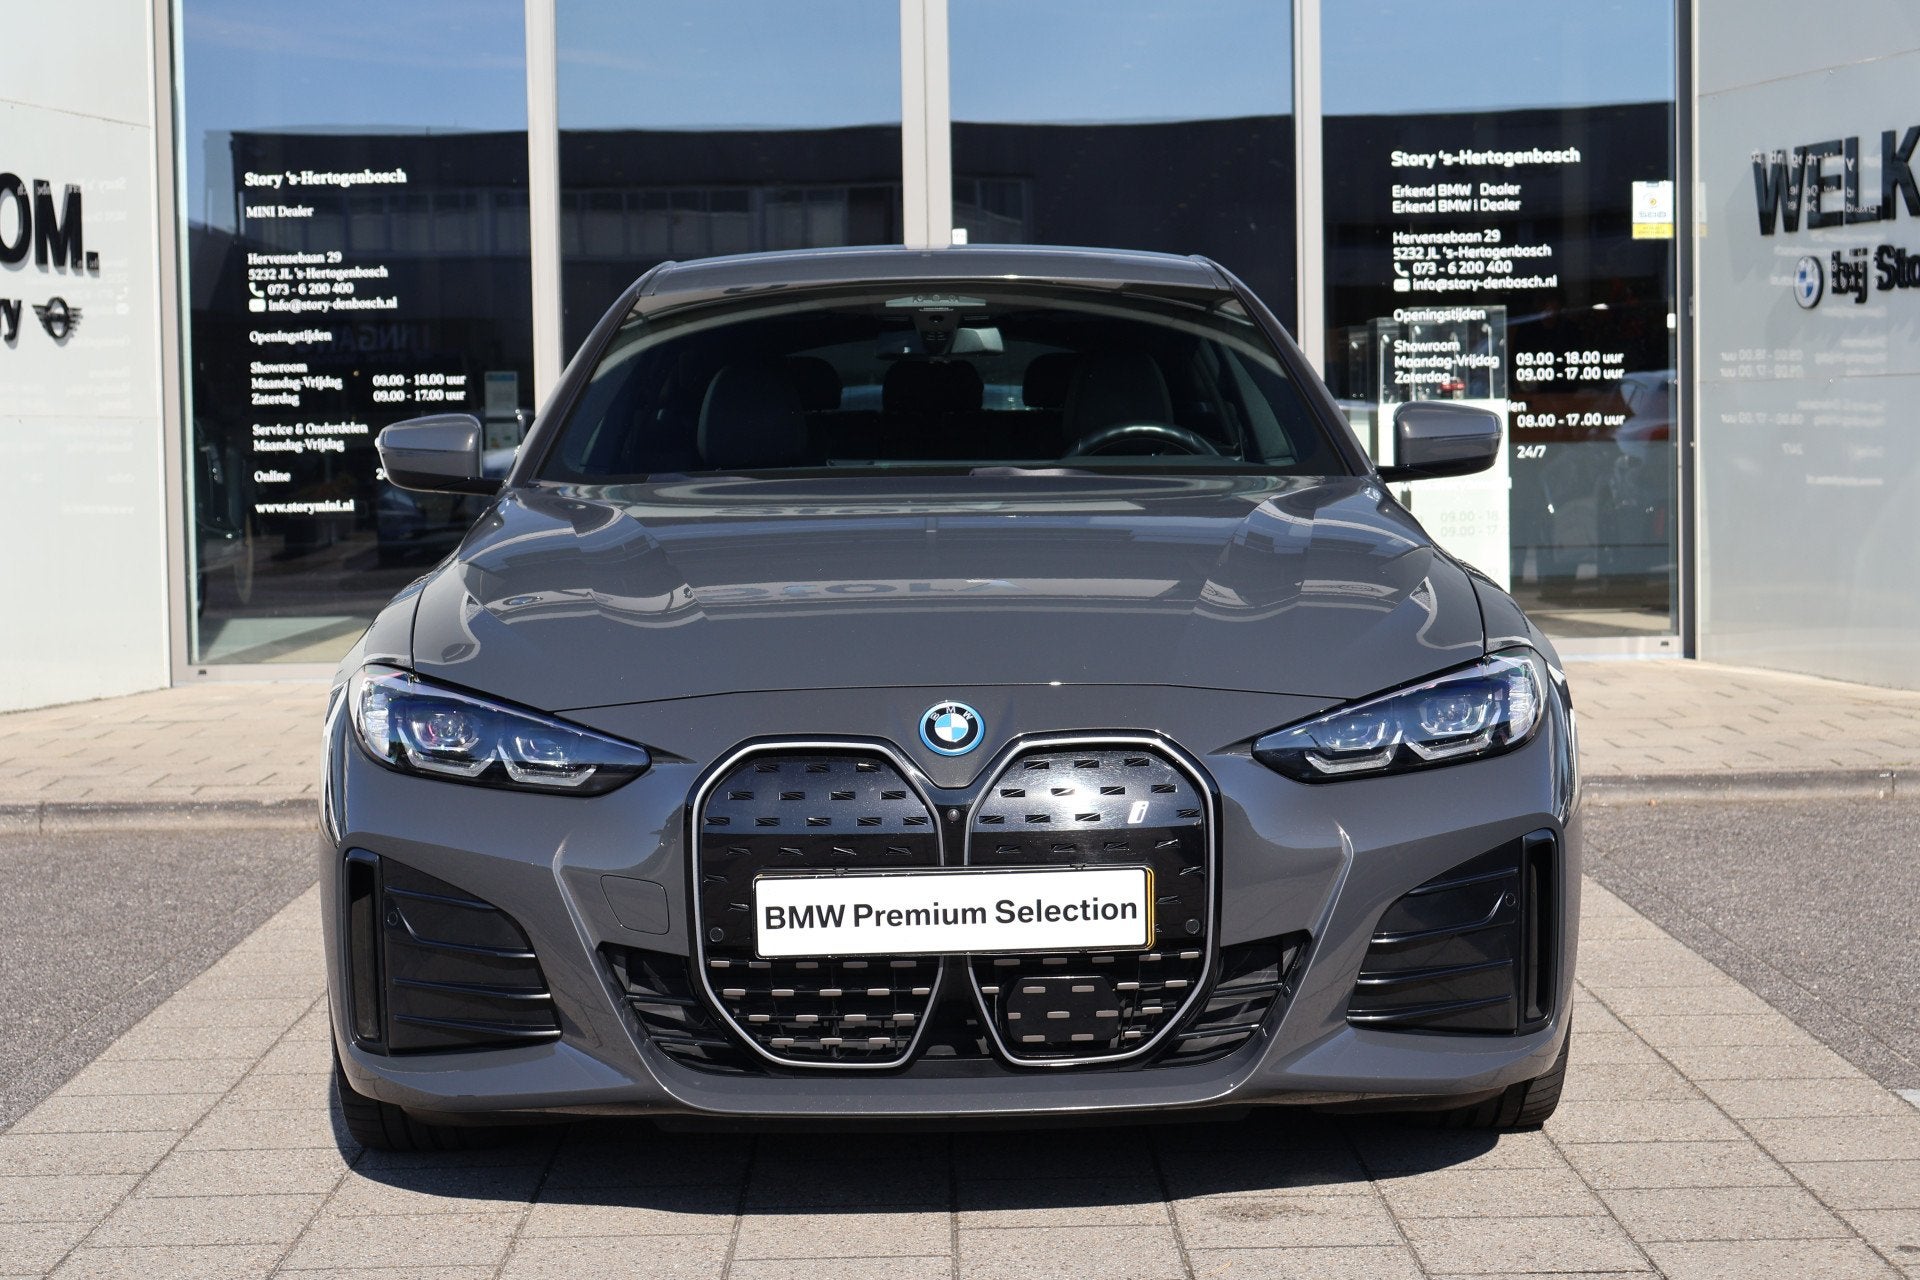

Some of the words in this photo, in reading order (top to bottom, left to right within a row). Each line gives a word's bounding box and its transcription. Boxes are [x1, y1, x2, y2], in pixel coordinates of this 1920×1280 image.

[1391, 150, 1436, 169] Story
[1438, 147, 1581, 167] 's-Hertogenbosch
[244, 171, 283, 189] Story
[286, 169, 407, 187] 's-Hertogenbosch
[1392, 185, 1435, 198] Erkend
[1437, 184, 1472, 196] BMW
[1479, 182, 1521, 196] Dealer
[246, 205, 276, 218] MINI
[278, 205, 314, 218] Dealer
[1392, 200, 1436, 214] Erkend
[1438, 199, 1472, 212] BMW
[1473, 199, 1479, 211] i
[1480, 198, 1521, 211] Dealer
[1393, 231, 1481, 245] Hervensebaan
[1483, 230, 1501, 242] 29
[247, 252, 325, 265] Hervensebaan
[327, 251, 342, 263] 29
[1393, 247, 1424, 260] 5232
[1443, 244, 1552, 259] 's-Hertogenbosch
[248, 268, 276, 280] 5232
[294, 266, 388, 280] 's-Hertogenbosch
[1412, 262, 1436, 276] 073
[1447, 262, 1457, 274] 6
[1458, 261, 1485, 274] 200
[1486, 261, 1513, 273] 400
[298, 283, 307, 295] 6
[308, 282, 330, 295] 200
[332, 282, 354, 294] 400
[1412, 275, 1558, 292] info@story-denbosch.nl
[268, 297, 398, 314] info@story-denbosch.nl
[1393, 308, 1486, 323] Openingstijden
[249, 329, 332, 345] Openingstijden
[1394, 340, 1460, 353] Showroom
[1394, 355, 1500, 368] Maandag-Vrijdag
[1515, 351, 1554, 366] 09.00
[1564, 351, 1601, 366] 18.00
[1603, 353, 1625, 364] uur
[250, 362, 308, 374] Showroom
[1516, 367, 1554, 382] 09.00
[1603, 369, 1625, 380] uur
[251, 376, 343, 390] Maandag-Vrijdag
[372, 374, 404, 386] 09.00
[414, 374, 444, 386] 18.00
[446, 376, 466, 386] uur
[1394, 371, 1451, 384] Zaterdag
[252, 393, 300, 406] Zaterdag
[373, 390, 404, 402] 09.00
[446, 391, 466, 401] uur
[1517, 413, 1556, 428] 08.00
[1604, 414, 1625, 426] uur
[252, 424, 293, 436] Service
[295, 423, 304, 435] &
[306, 422, 368, 434] Onderdelen
[254, 438, 344, 452] Maandag-Vrijdag
[1516, 445, 1546, 459] 24/7
[254, 470, 291, 483] Online
[255, 499, 355, 516] www.storymini.nl
[1128, 801, 1149, 824] i
[764, 904, 845, 930] BMW
[853, 902, 987, 927] Premium
[995, 897, 1138, 924] Selection
